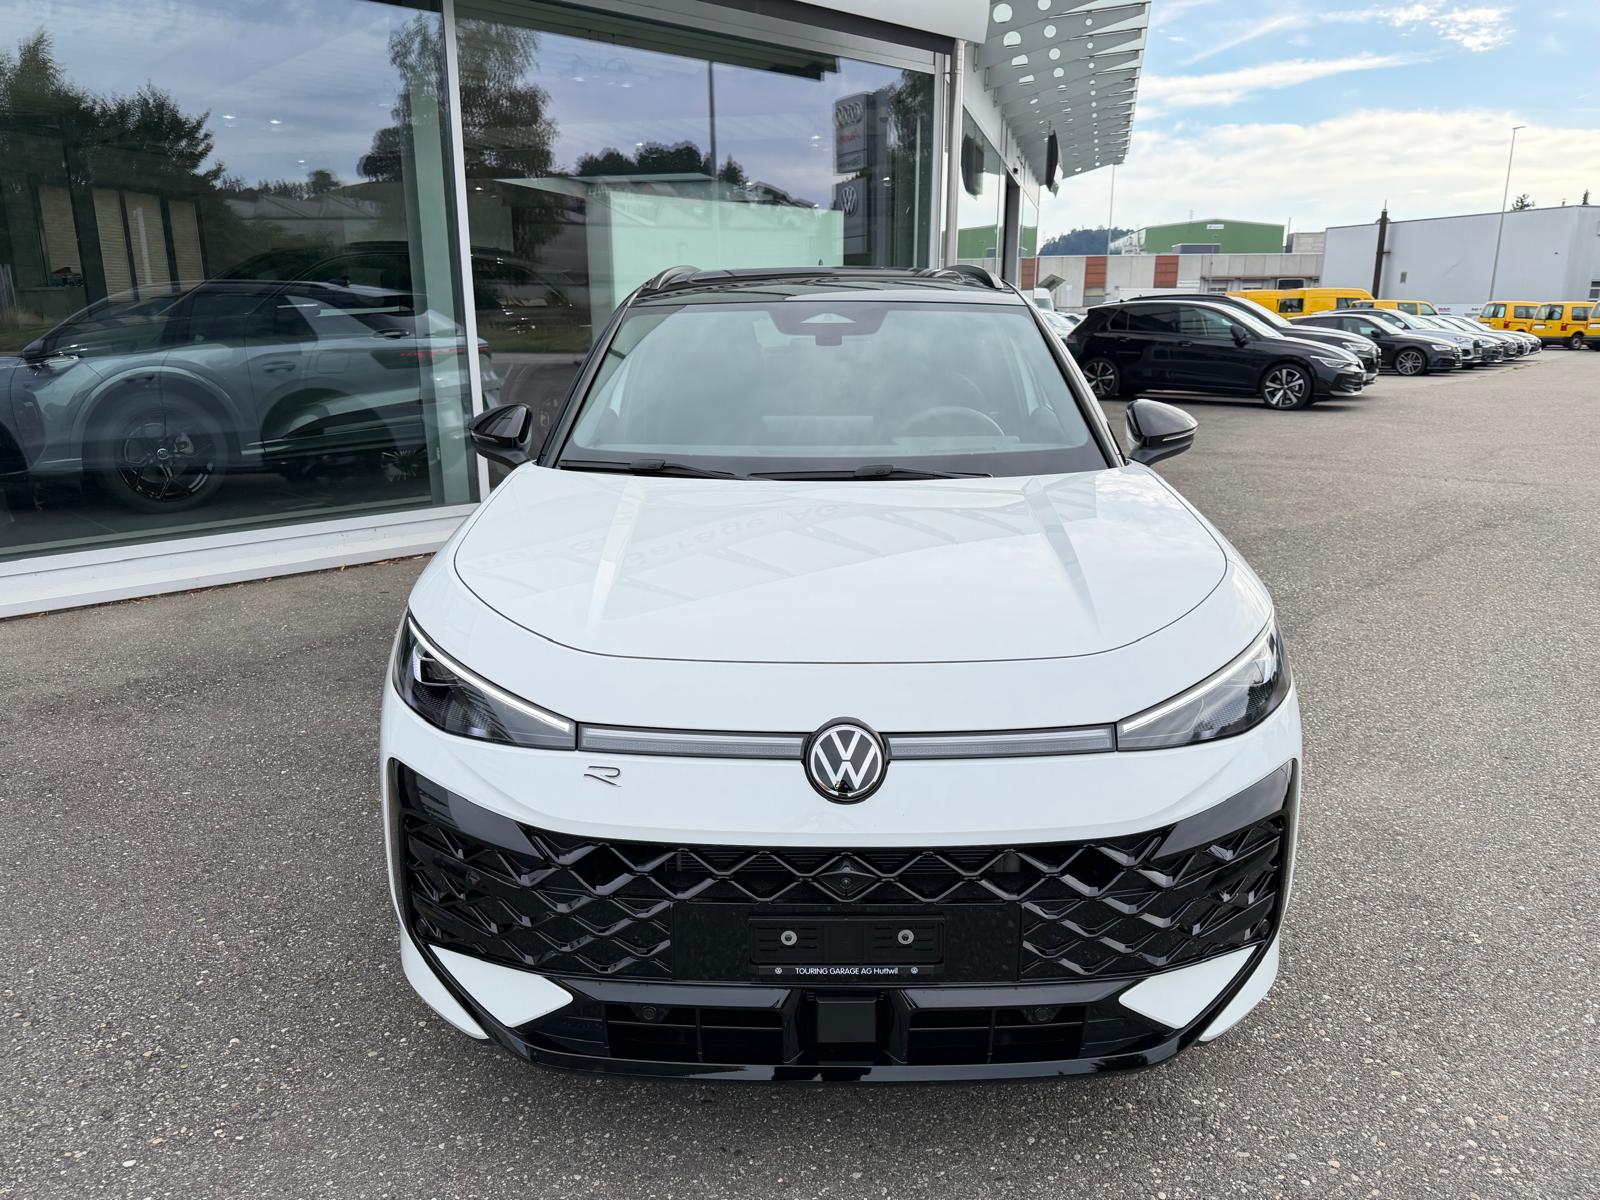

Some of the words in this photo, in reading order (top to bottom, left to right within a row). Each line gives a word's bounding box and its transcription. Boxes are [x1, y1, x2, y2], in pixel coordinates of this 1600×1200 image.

[812, 725, 882, 794] VW
[584, 765, 621, 787] R
[795, 967, 828, 975] TOURING
[829, 967, 860, 975] GARAGE
[861, 967, 872, 975] AG
[873, 967, 899, 975] Huttwil
